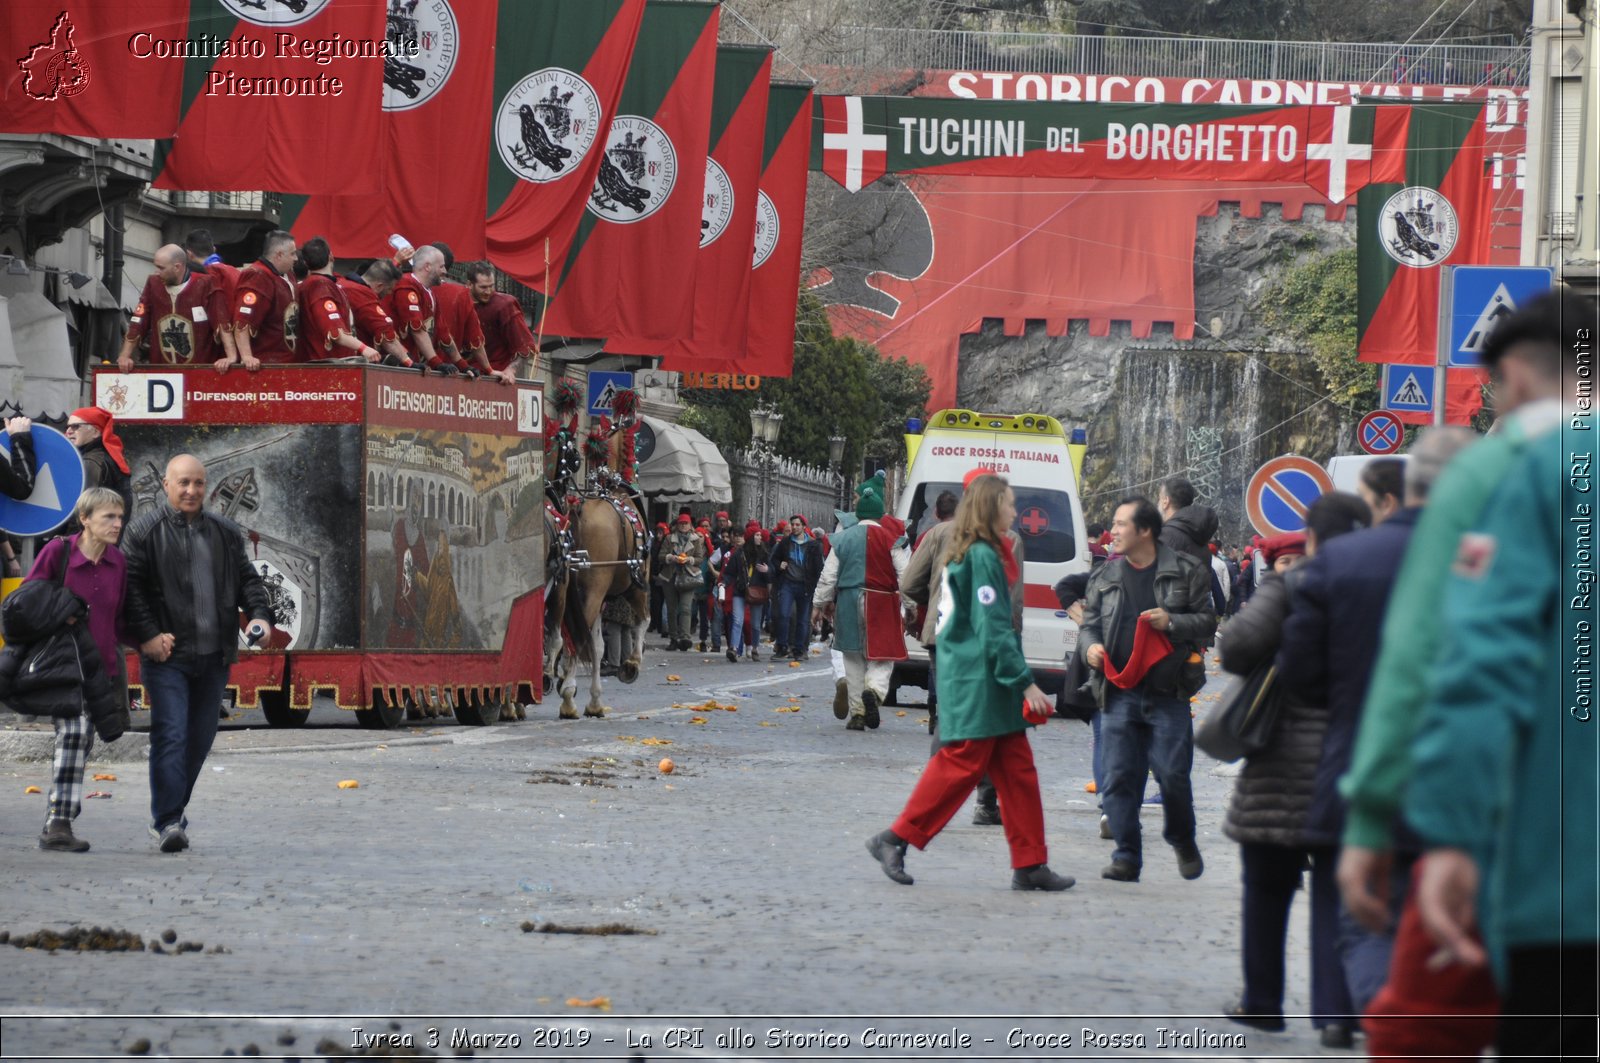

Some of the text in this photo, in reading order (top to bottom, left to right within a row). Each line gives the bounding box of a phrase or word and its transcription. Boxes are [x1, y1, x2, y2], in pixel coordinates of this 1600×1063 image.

[426, 2, 453, 88] BORGHETTO
[513, 72, 559, 100] TUCHINI
[563, 75, 585, 95] DEL
[948, 72, 1165, 103] STORICO
[570, 94, 597, 164] BORGHETTO
[899, 117, 1297, 163] TUCHINI DEL BORGHETTO
[637, 121, 656, 138] DEL
[650, 138, 673, 205] BORGHETTO
[709, 173, 730, 235] BORGHETTO
[756, 201, 776, 259] BORGHETTO
[147, 379, 175, 413] D
[186, 391, 190, 401] I
[193, 391, 257, 401] DIFENSORI
[284, 390, 356, 401] BORGHETTO
[683, 371, 760, 390] MERLO
[377, 385, 381, 408] I
[383, 386, 435, 414] DIFENSORI
[458, 394, 514, 421] BORGHETTO
[531, 395, 540, 427] D
[931, 446, 1060, 464] CROCE ROSSA ITALIANA
[977, 461, 1011, 473] IVREA
